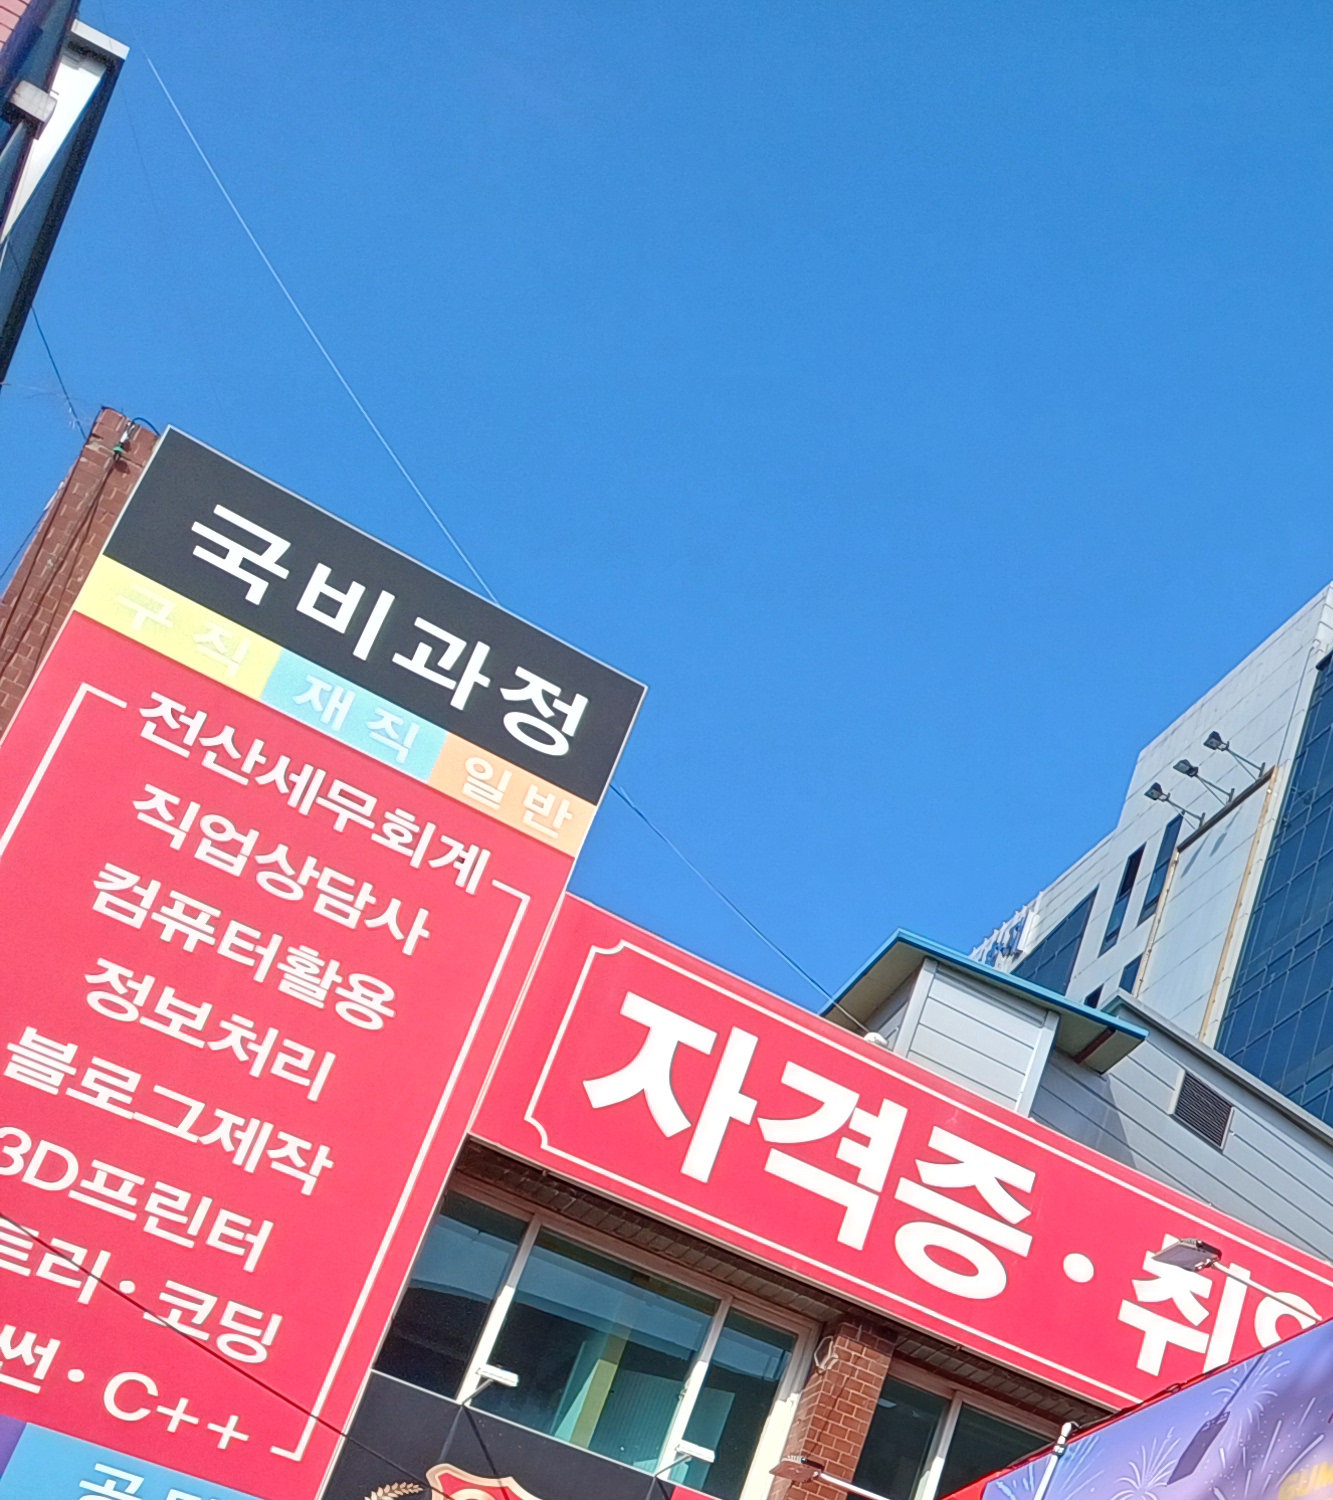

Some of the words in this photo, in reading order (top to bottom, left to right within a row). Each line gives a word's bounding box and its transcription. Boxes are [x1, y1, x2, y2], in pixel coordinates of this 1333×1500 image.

[191, 504, 588, 758] 국비과정
[133, 783, 431, 957] 직업상담사
[138, 691, 493, 895] 전산세무회계
[85, 957, 336, 1101] 정보처리
[93, 862, 395, 1031] 컴퓨터활용
[3, 1026, 334, 1196] 블로그제작
[0, 1126, 273, 1274] 3D프린터
